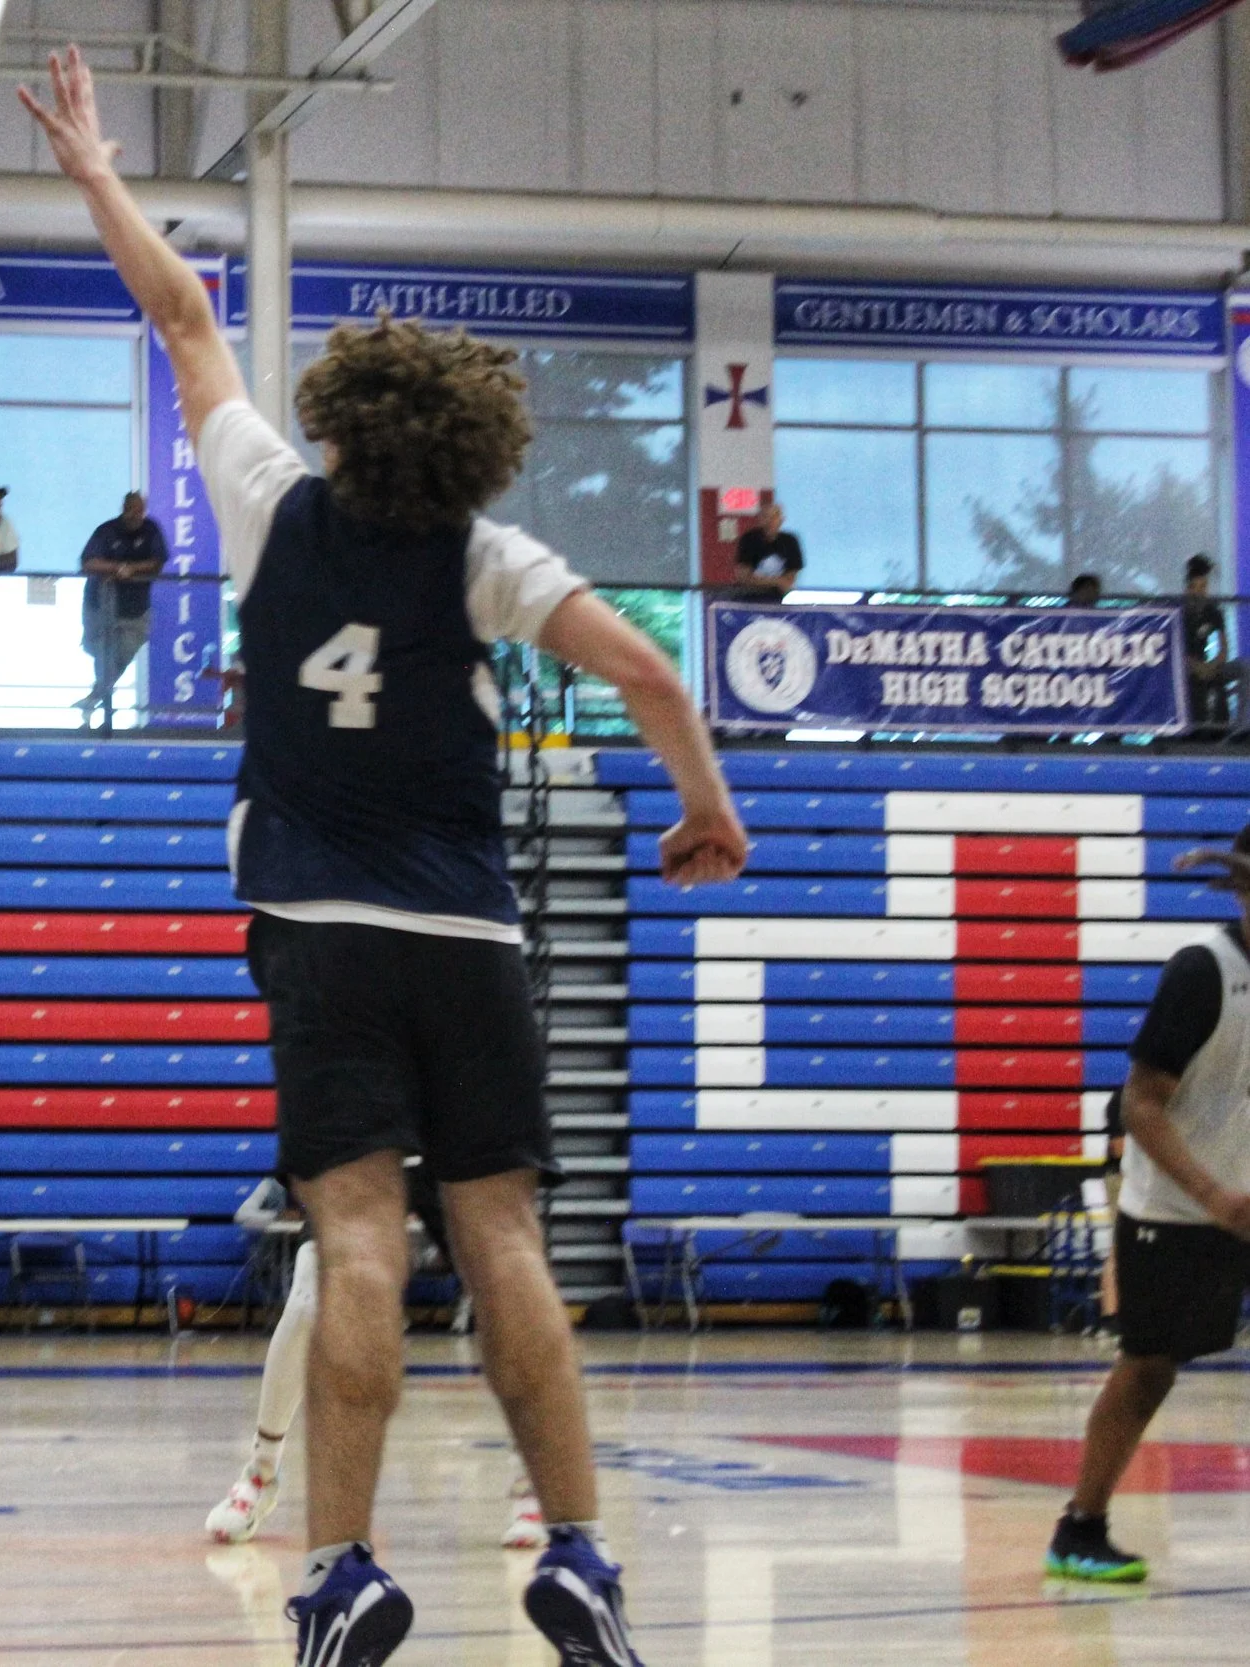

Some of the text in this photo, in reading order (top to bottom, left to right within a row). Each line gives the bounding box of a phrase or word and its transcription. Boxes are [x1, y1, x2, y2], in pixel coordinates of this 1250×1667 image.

[350, 282, 572, 318] FAITH-FILLED
[794, 299, 1200, 338] GENTLEMEN & SCHOLARS
[825, 629, 1166, 668] DeMATHA CATHOLIC
[298, 622, 383, 729] 4
[881, 671, 1116, 708] HIGH SCHOOL
